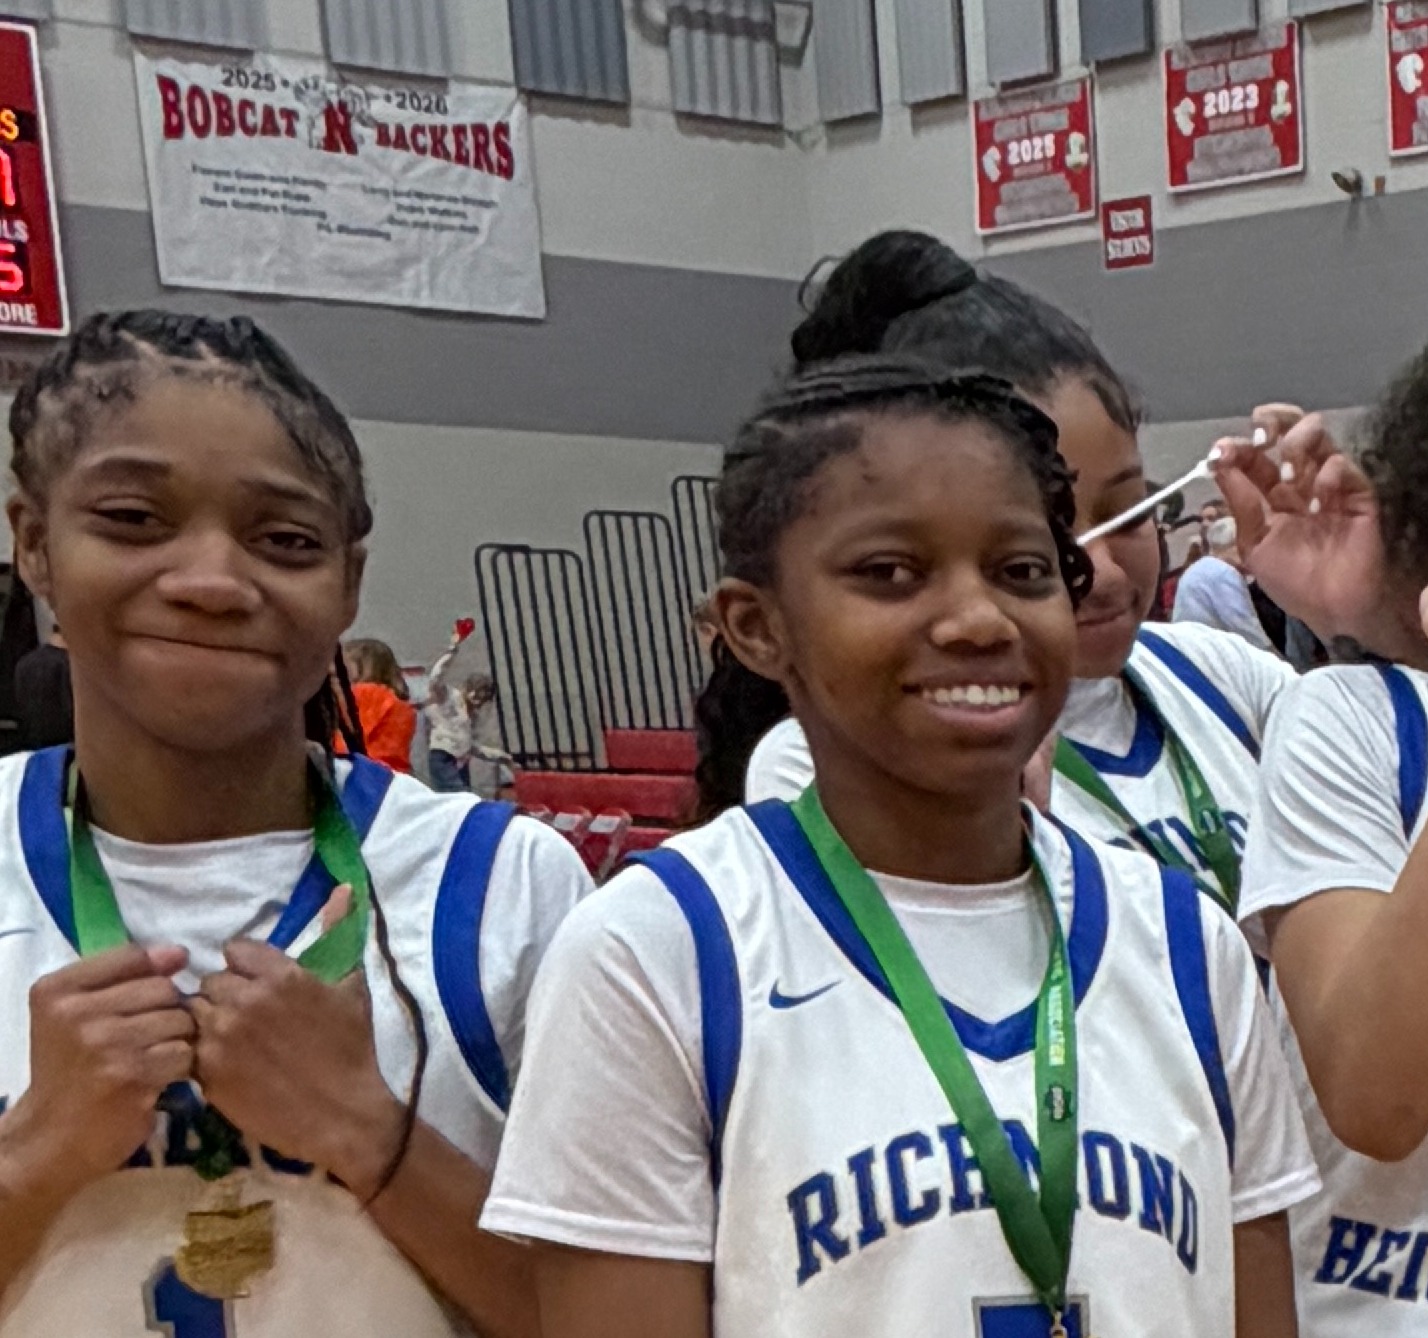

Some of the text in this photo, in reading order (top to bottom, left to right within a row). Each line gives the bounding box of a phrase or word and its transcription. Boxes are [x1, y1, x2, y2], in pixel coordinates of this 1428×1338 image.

[220, 67, 276, 92] 2025
[1203, 83, 1259, 118] 2023
[156, 74, 301, 140] BOBCAT
[322, 100, 358, 156] N
[374, 120, 514, 181] BACKERS
[0, 302, 38, 326] ORE
